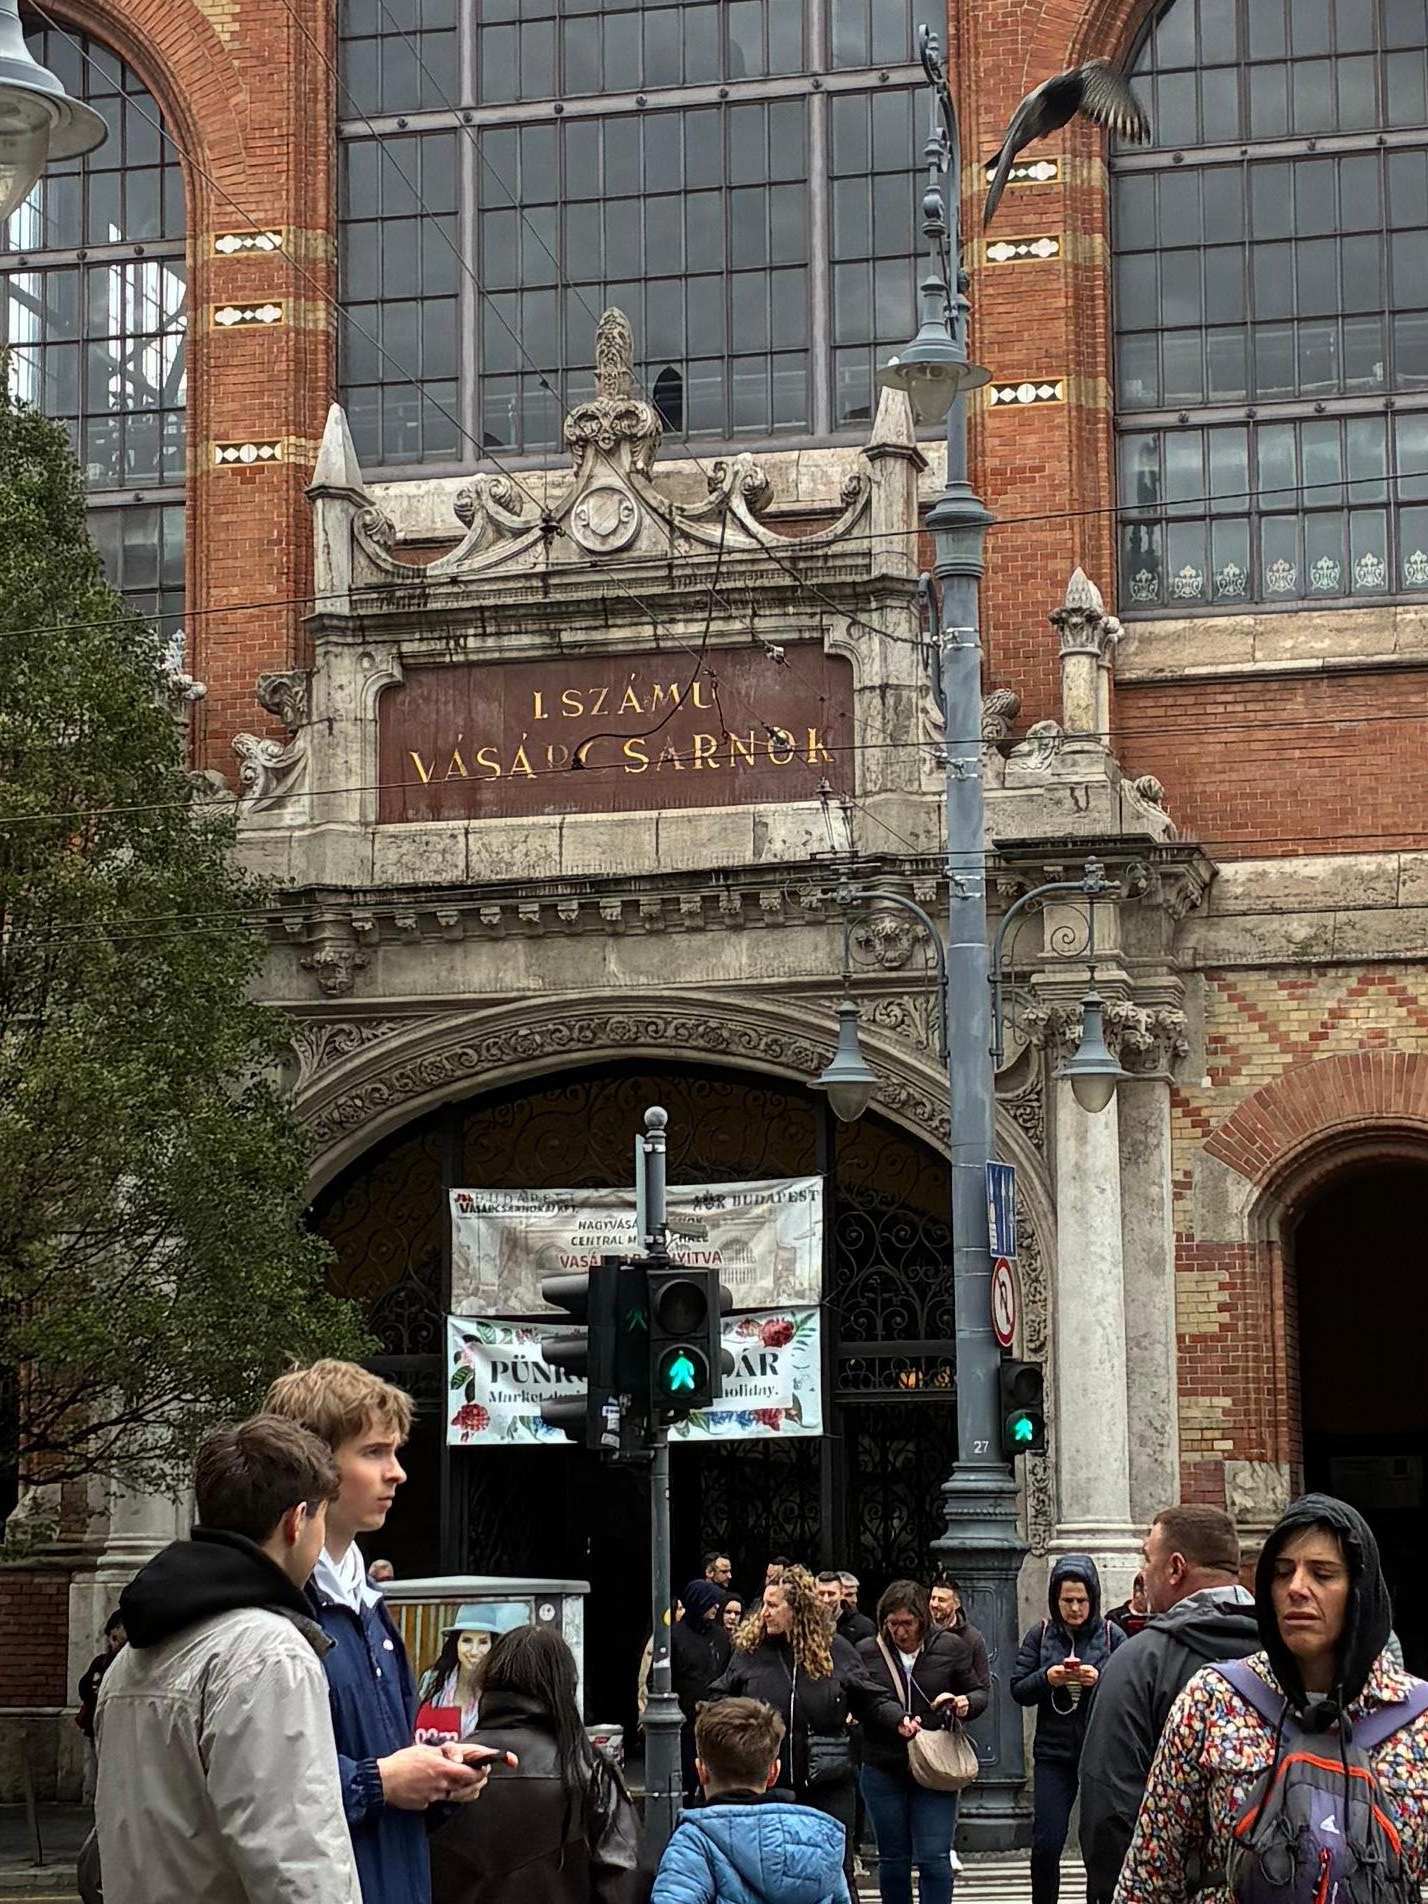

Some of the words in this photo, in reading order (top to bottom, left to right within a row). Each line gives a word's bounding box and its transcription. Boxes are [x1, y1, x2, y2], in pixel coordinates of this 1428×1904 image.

[732, 1189, 820, 1207] BUDAPEST
[571, 1235, 623, 1246] CENTRAL
[670, 1251, 722, 1264] YITVA
[973, 1440, 989, 1454] 27
